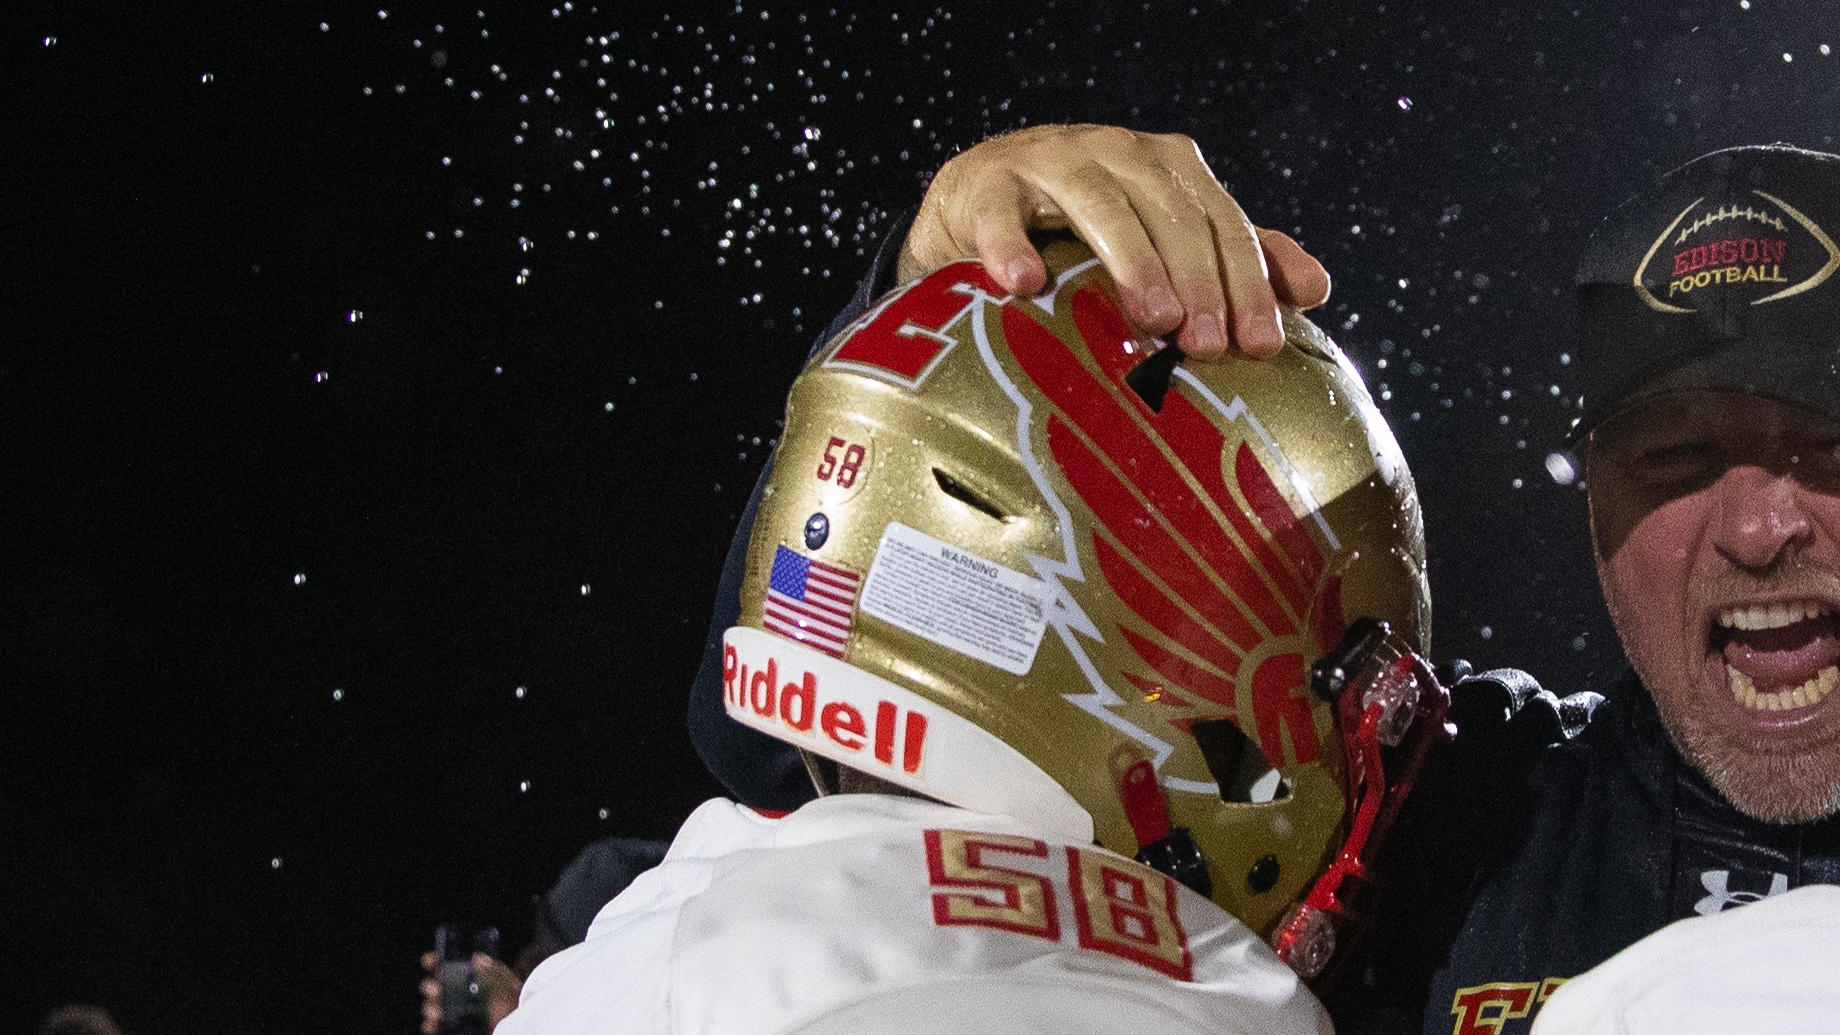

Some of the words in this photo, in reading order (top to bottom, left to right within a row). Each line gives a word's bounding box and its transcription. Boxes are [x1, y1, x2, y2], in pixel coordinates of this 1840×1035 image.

[1669, 262, 1788, 298] FOOTBALL
[1672, 237, 1787, 278] EDISON
[822, 259, 1014, 390] E
[816, 436, 867, 490] 58
[940, 547, 1000, 580] WARNING
[723, 643, 928, 775] Riddell
[923, 829, 1194, 983] 58
